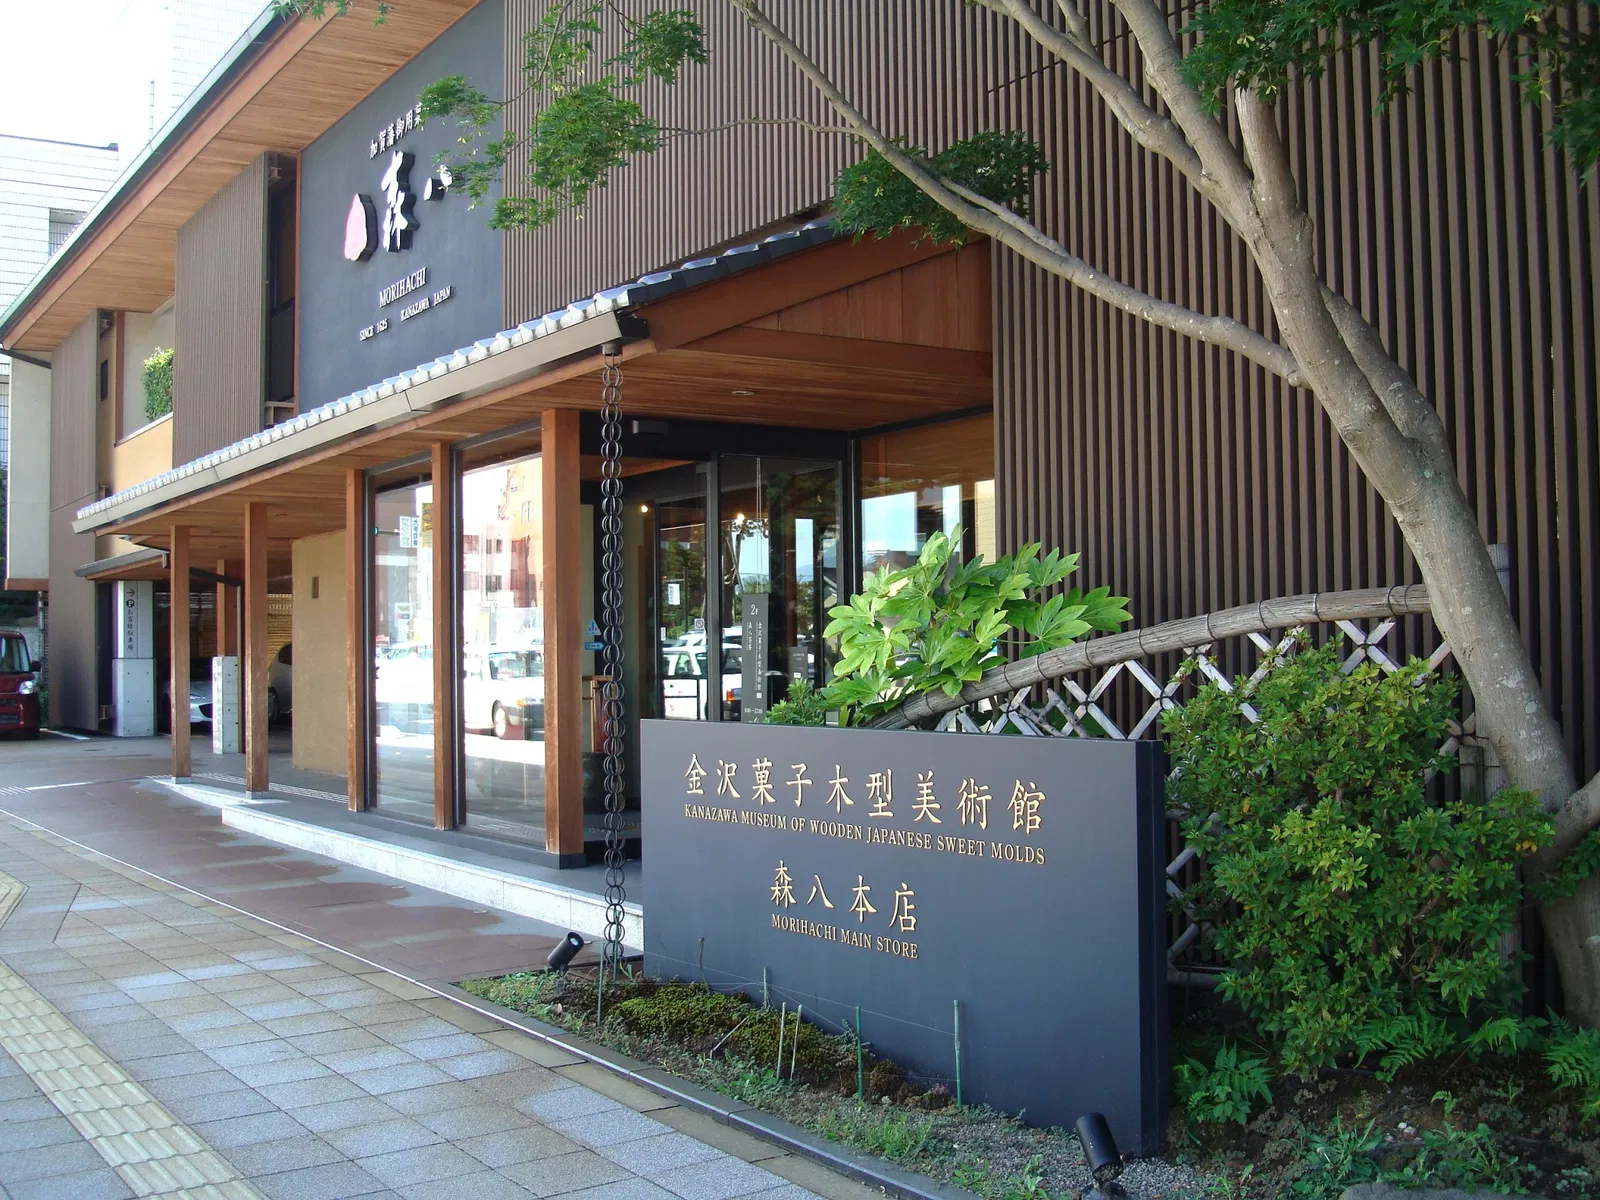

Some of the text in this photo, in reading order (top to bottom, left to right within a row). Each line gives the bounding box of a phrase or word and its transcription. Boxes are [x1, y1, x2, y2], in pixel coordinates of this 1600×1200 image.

[359, 325, 374, 341] SINCE
[400, 297, 430, 322] KANAZAWA
[433, 286, 451, 306] JAPAN
[379, 267, 426, 308] MORIHACHI
[750, 604, 759, 615] 2F
[684, 753, 1047, 835] 金沢菓子木型美術館
[684, 804, 1046, 865] KANAZAWA MUSEUM OF WOODEN JAPANESE SWEET MOLDS
[770, 859, 919, 933] 森八本店
[772, 913, 919, 960] MORIHACHI MAIN STORE
